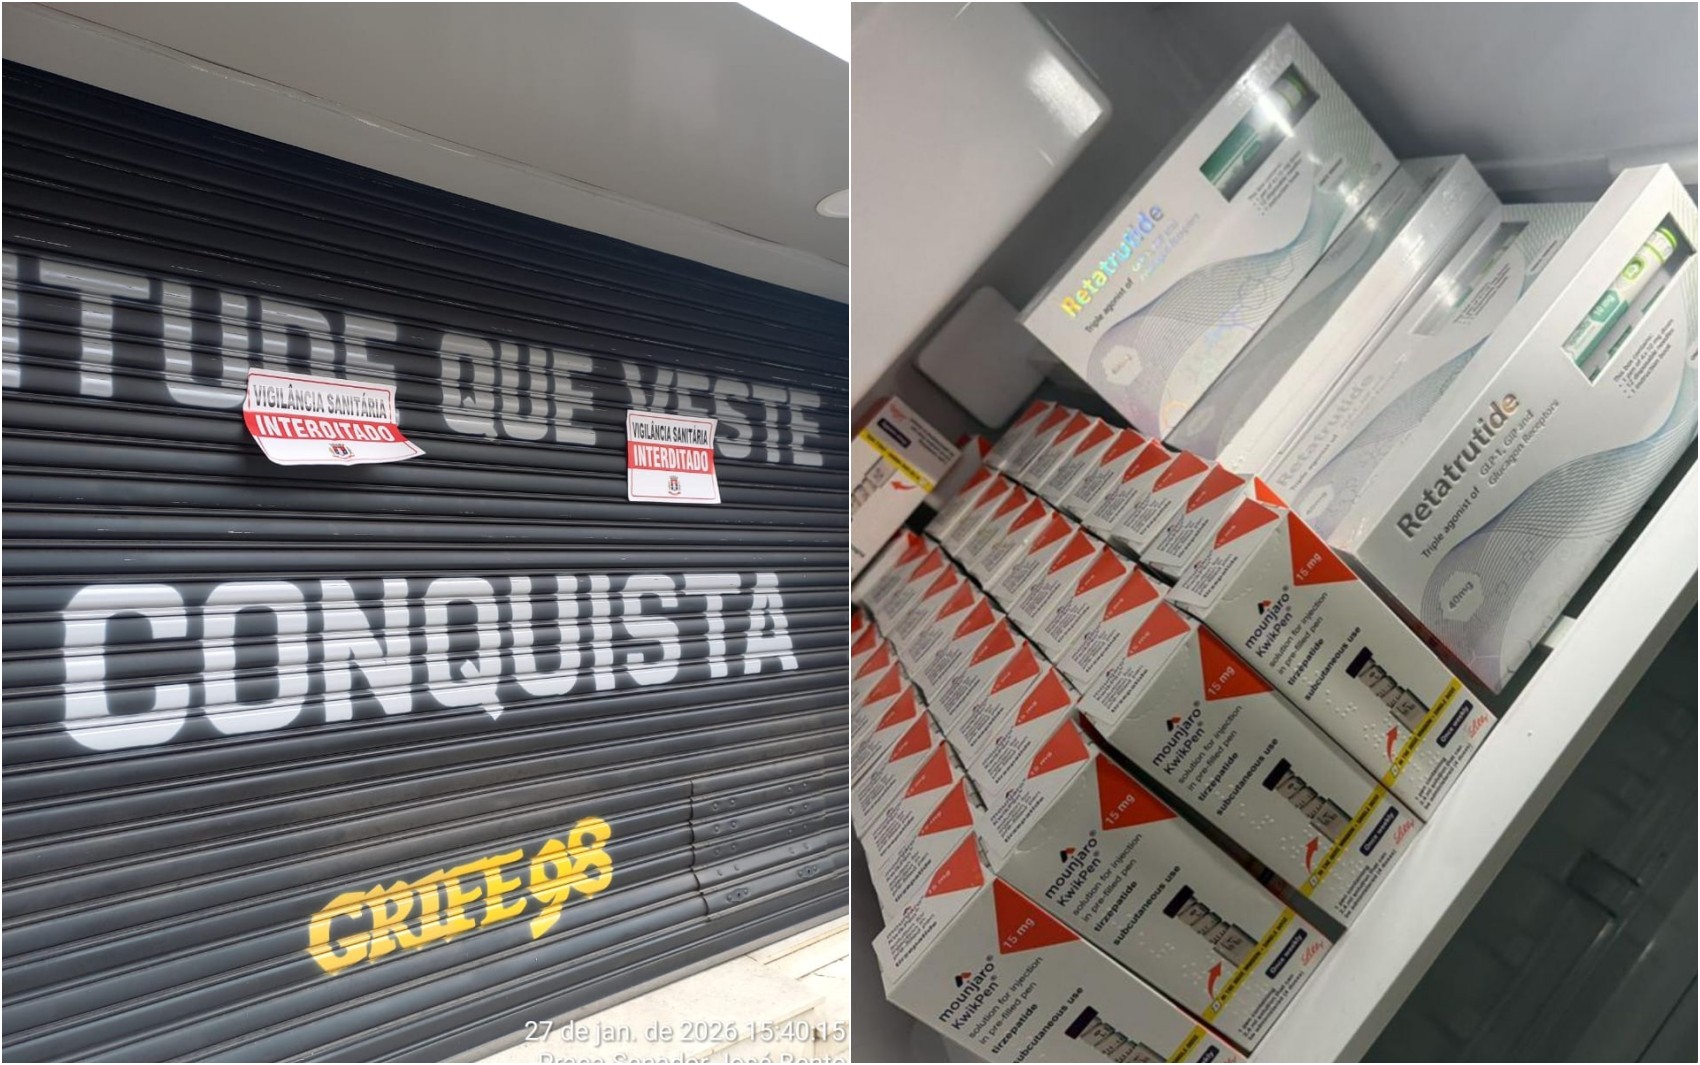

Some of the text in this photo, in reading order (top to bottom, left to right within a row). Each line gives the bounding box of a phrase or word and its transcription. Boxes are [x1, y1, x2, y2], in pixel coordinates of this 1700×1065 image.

[1060, 205, 1164, 318] Retatrutide
[1084, 277, 1133, 332] Triple agonist of
[253, 384, 387, 419] VIGILÂNCIA SANITÁRIA
[255, 415, 395, 442] INTERDITADO
[440, 333, 597, 445] QUE
[621, 360, 823, 467] VESTE
[1503, 427, 1521, 448] GIP
[1517, 408, 1534, 430] and
[632, 421, 708, 445] VIGILÂNCIA SANITÁRIA
[633, 444, 708, 472] INTERDITADO
[1486, 398, 1561, 487] Glucagon Receptors
[1395, 392, 1521, 540] Retatrutide
[1420, 485, 1480, 557] Triple agonist of
[1295, 552, 1322, 580] 15 mg
[1448, 580, 1474, 609] 40mg
[1268, 592, 1327, 667] solution for injection
[1277, 616, 1323, 675] in pre-filled pen
[61, 573, 799, 750] CONQUISTA
[1207, 665, 1235, 695] 15 mg
[1287, 638, 1324, 685] tirzepatide
[1304, 626, 1360, 700] subcutaneous use
[1177, 705, 1242, 784] solution for injection
[1186, 729, 1237, 791] in pre-filled pen
[1197, 752, 1238, 801] tirzepatide
[1216, 738, 1278, 815] subcutaneous use
[1104, 793, 1135, 824] 15 mg
[1072, 833, 1142, 916] solution for injection
[1081, 858, 1136, 922] in pre-filled pen
[1002, 917, 1035, 948] 15 mg
[1093, 881, 1137, 931] tirzepatide
[1113, 865, 1180, 945] subcutaneous use
[968, 956, 1043, 1038] solution for injection
[978, 981, 1037, 1044] in pre-filled pen
[1066, 986, 1083, 1004] use
[991, 1003, 1037, 1053] tirzepatide
